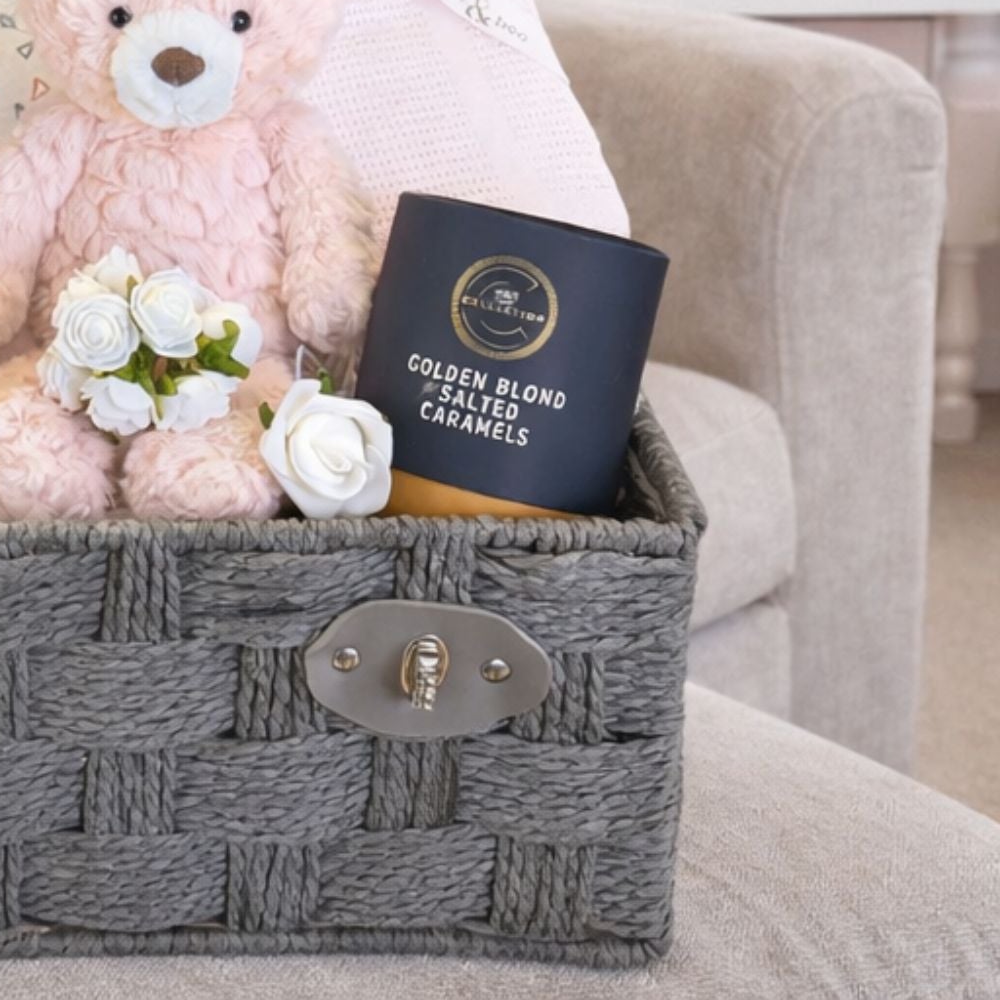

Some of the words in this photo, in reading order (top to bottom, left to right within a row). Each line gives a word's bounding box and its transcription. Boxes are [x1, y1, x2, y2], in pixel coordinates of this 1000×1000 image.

[407, 353, 488, 391] GOLDEN
[495, 377, 567, 410] BLOND
[438, 384, 519, 421] SALTED
[419, 400, 530, 447] CARAMELS
